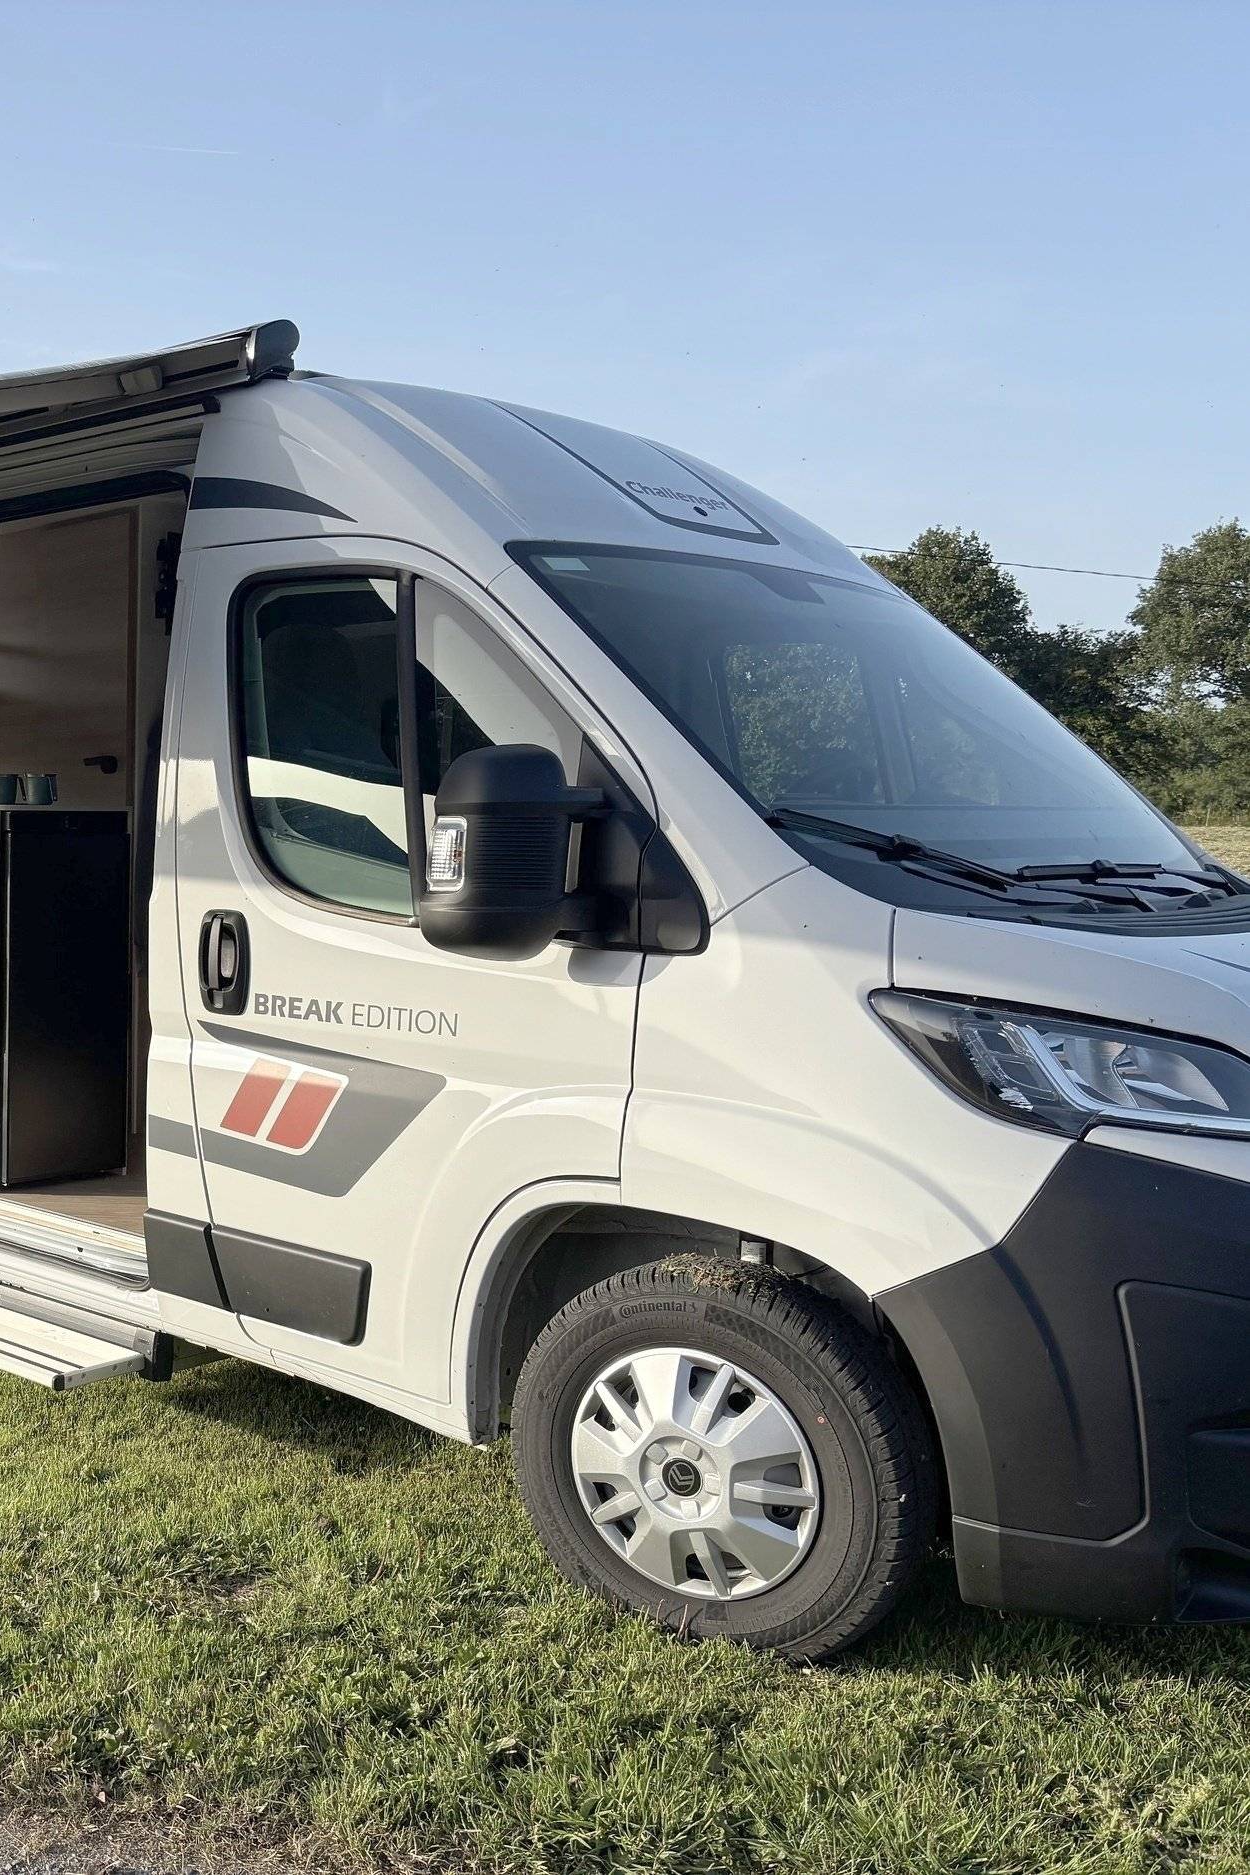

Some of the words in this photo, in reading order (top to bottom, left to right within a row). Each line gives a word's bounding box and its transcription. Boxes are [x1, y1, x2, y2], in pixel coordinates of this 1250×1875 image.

[625, 480, 730, 511] Challenger
[254, 993, 344, 1025] BREAK
[351, 1003, 458, 1037] EDITION
[619, 1300, 687, 1318] Continental
